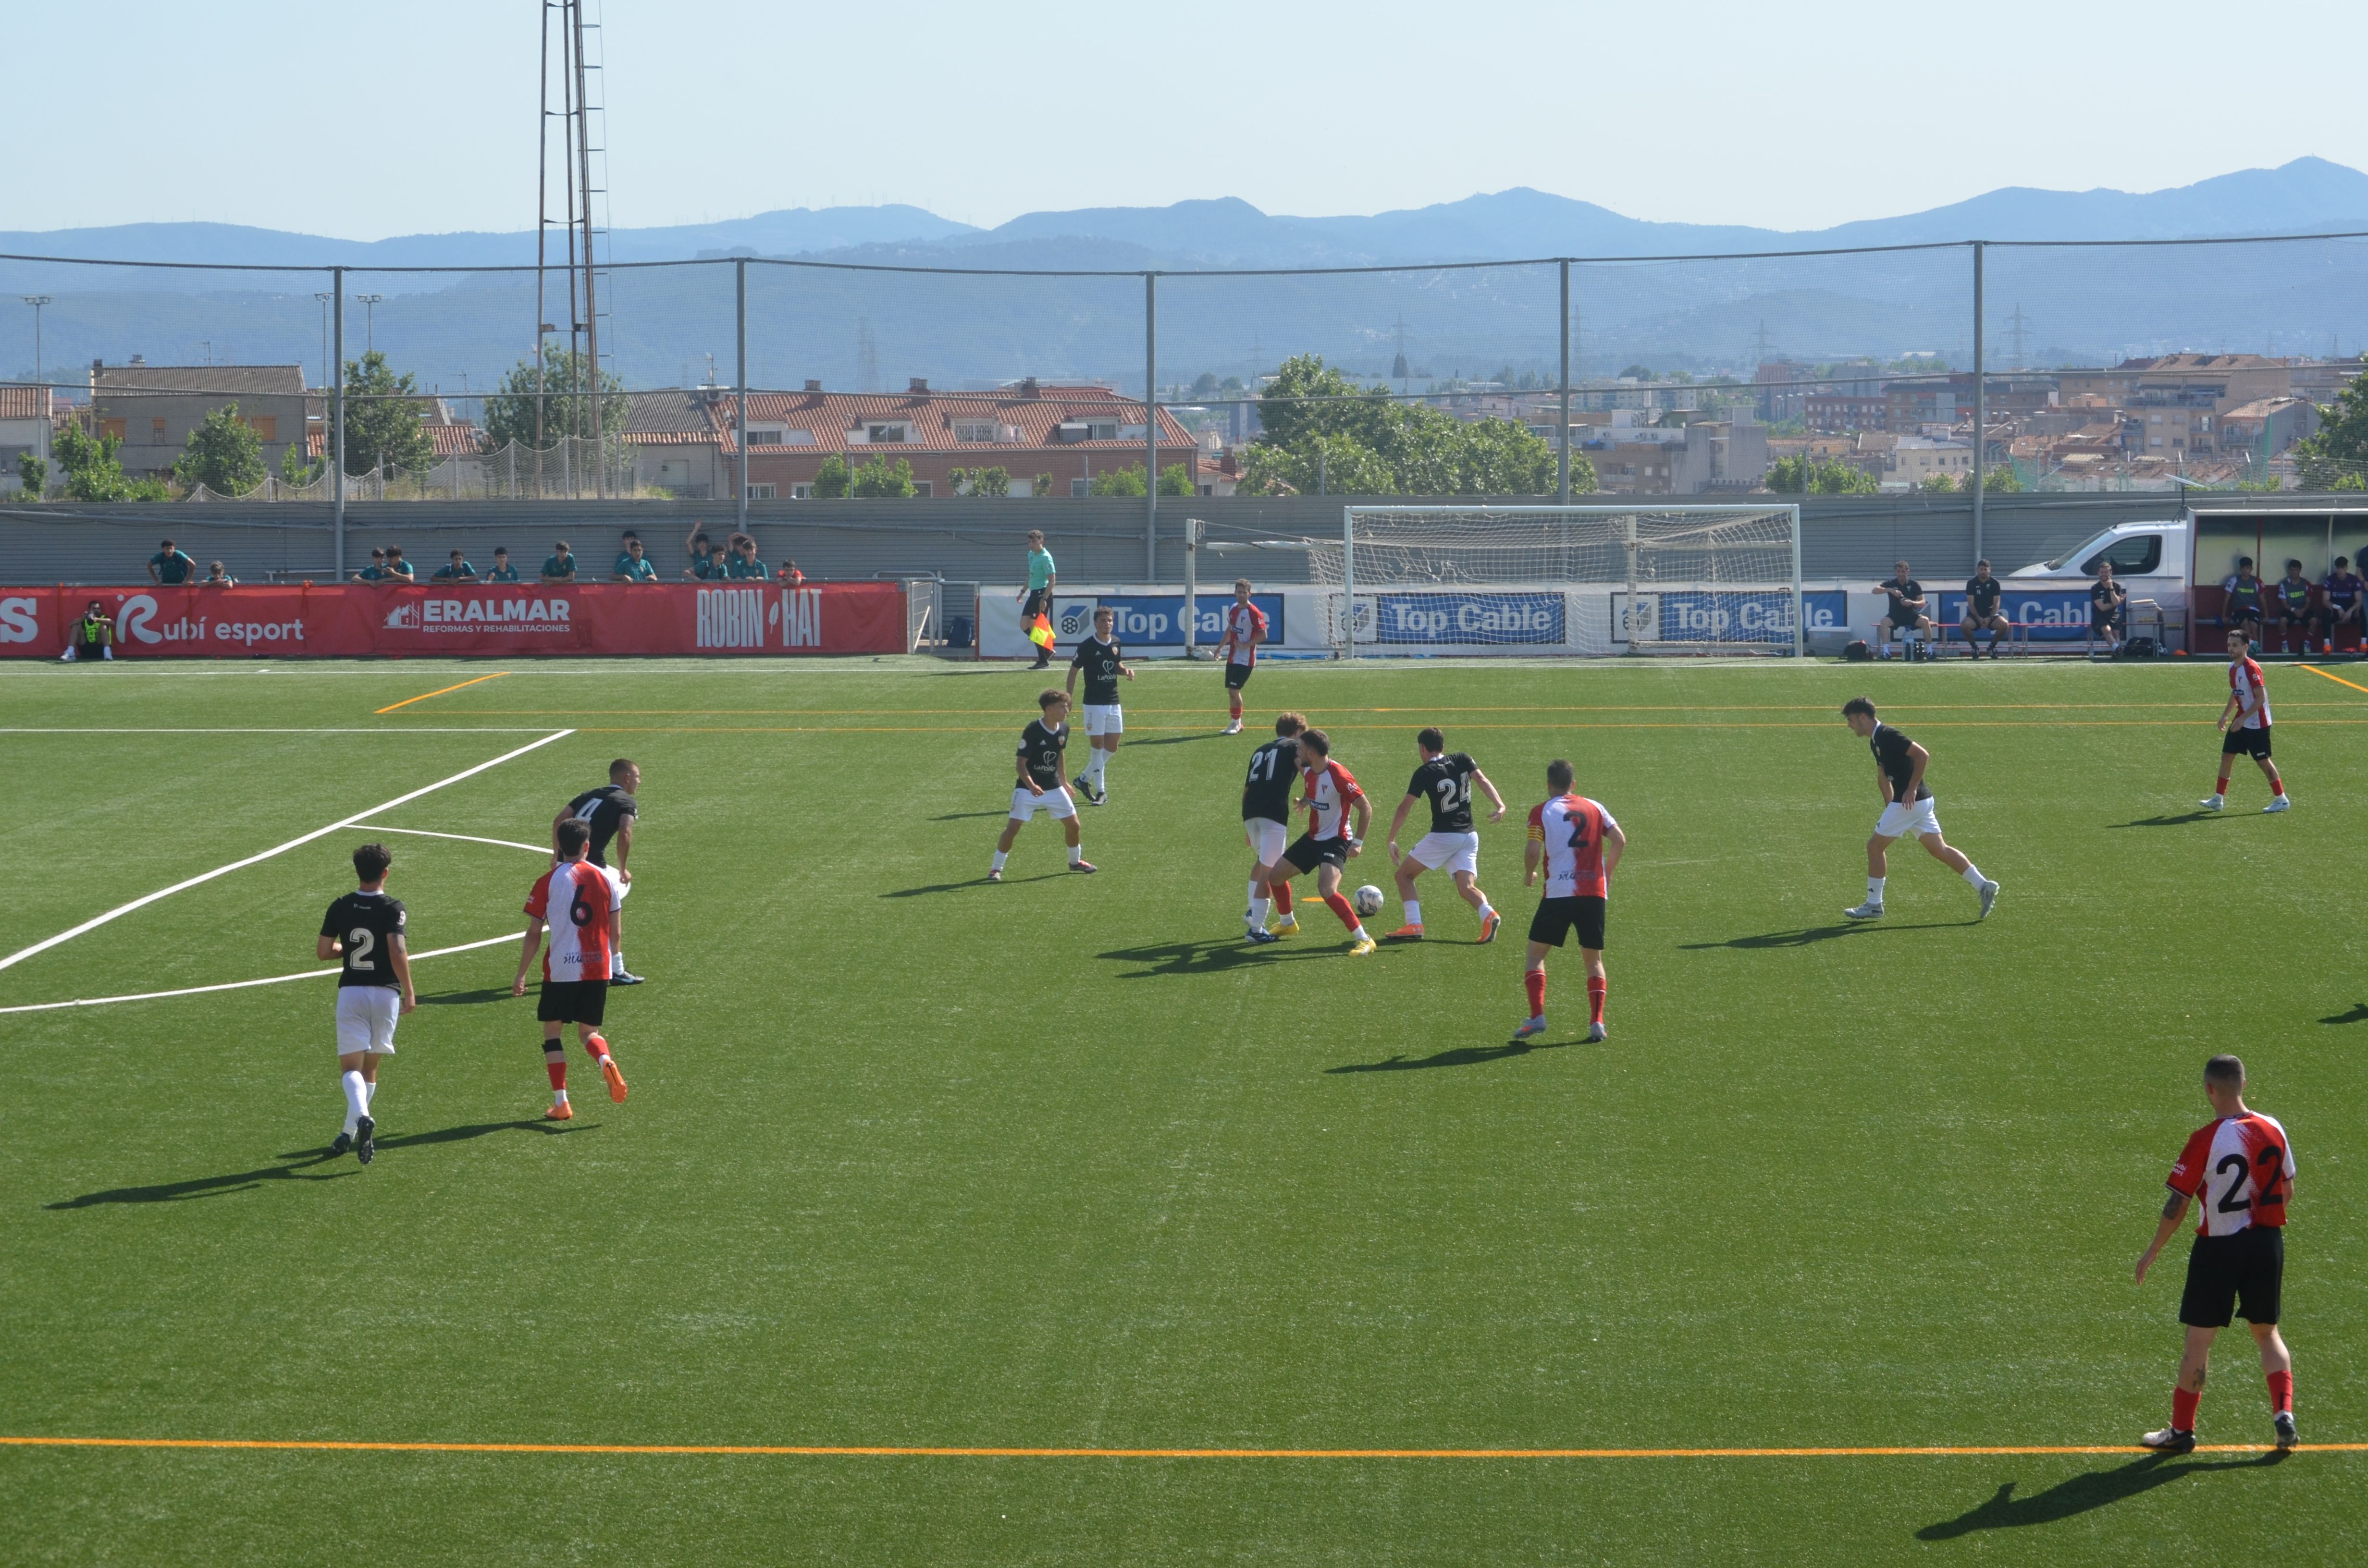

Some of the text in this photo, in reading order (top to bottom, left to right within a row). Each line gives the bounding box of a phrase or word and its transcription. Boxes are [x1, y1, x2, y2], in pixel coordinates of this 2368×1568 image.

[423, 600, 570, 622] ERALMAR
[697, 588, 822, 648] ROBIN HAT
[1111, 606, 1168, 640] Top
[1391, 603, 1551, 638] Top Cable
[1673, 603, 1730, 637] Top
[2019, 601, 2091, 628] Cabl
[215, 619, 304, 646] esport
[1248, 748, 1278, 783] 21
[1437, 771, 1471, 813] 24
[575, 797, 604, 823] 4
[1563, 810, 1589, 847] 2
[570, 884, 592, 927] 6
[349, 928, 375, 970] 2
[2216, 1145, 2283, 1214] 22
